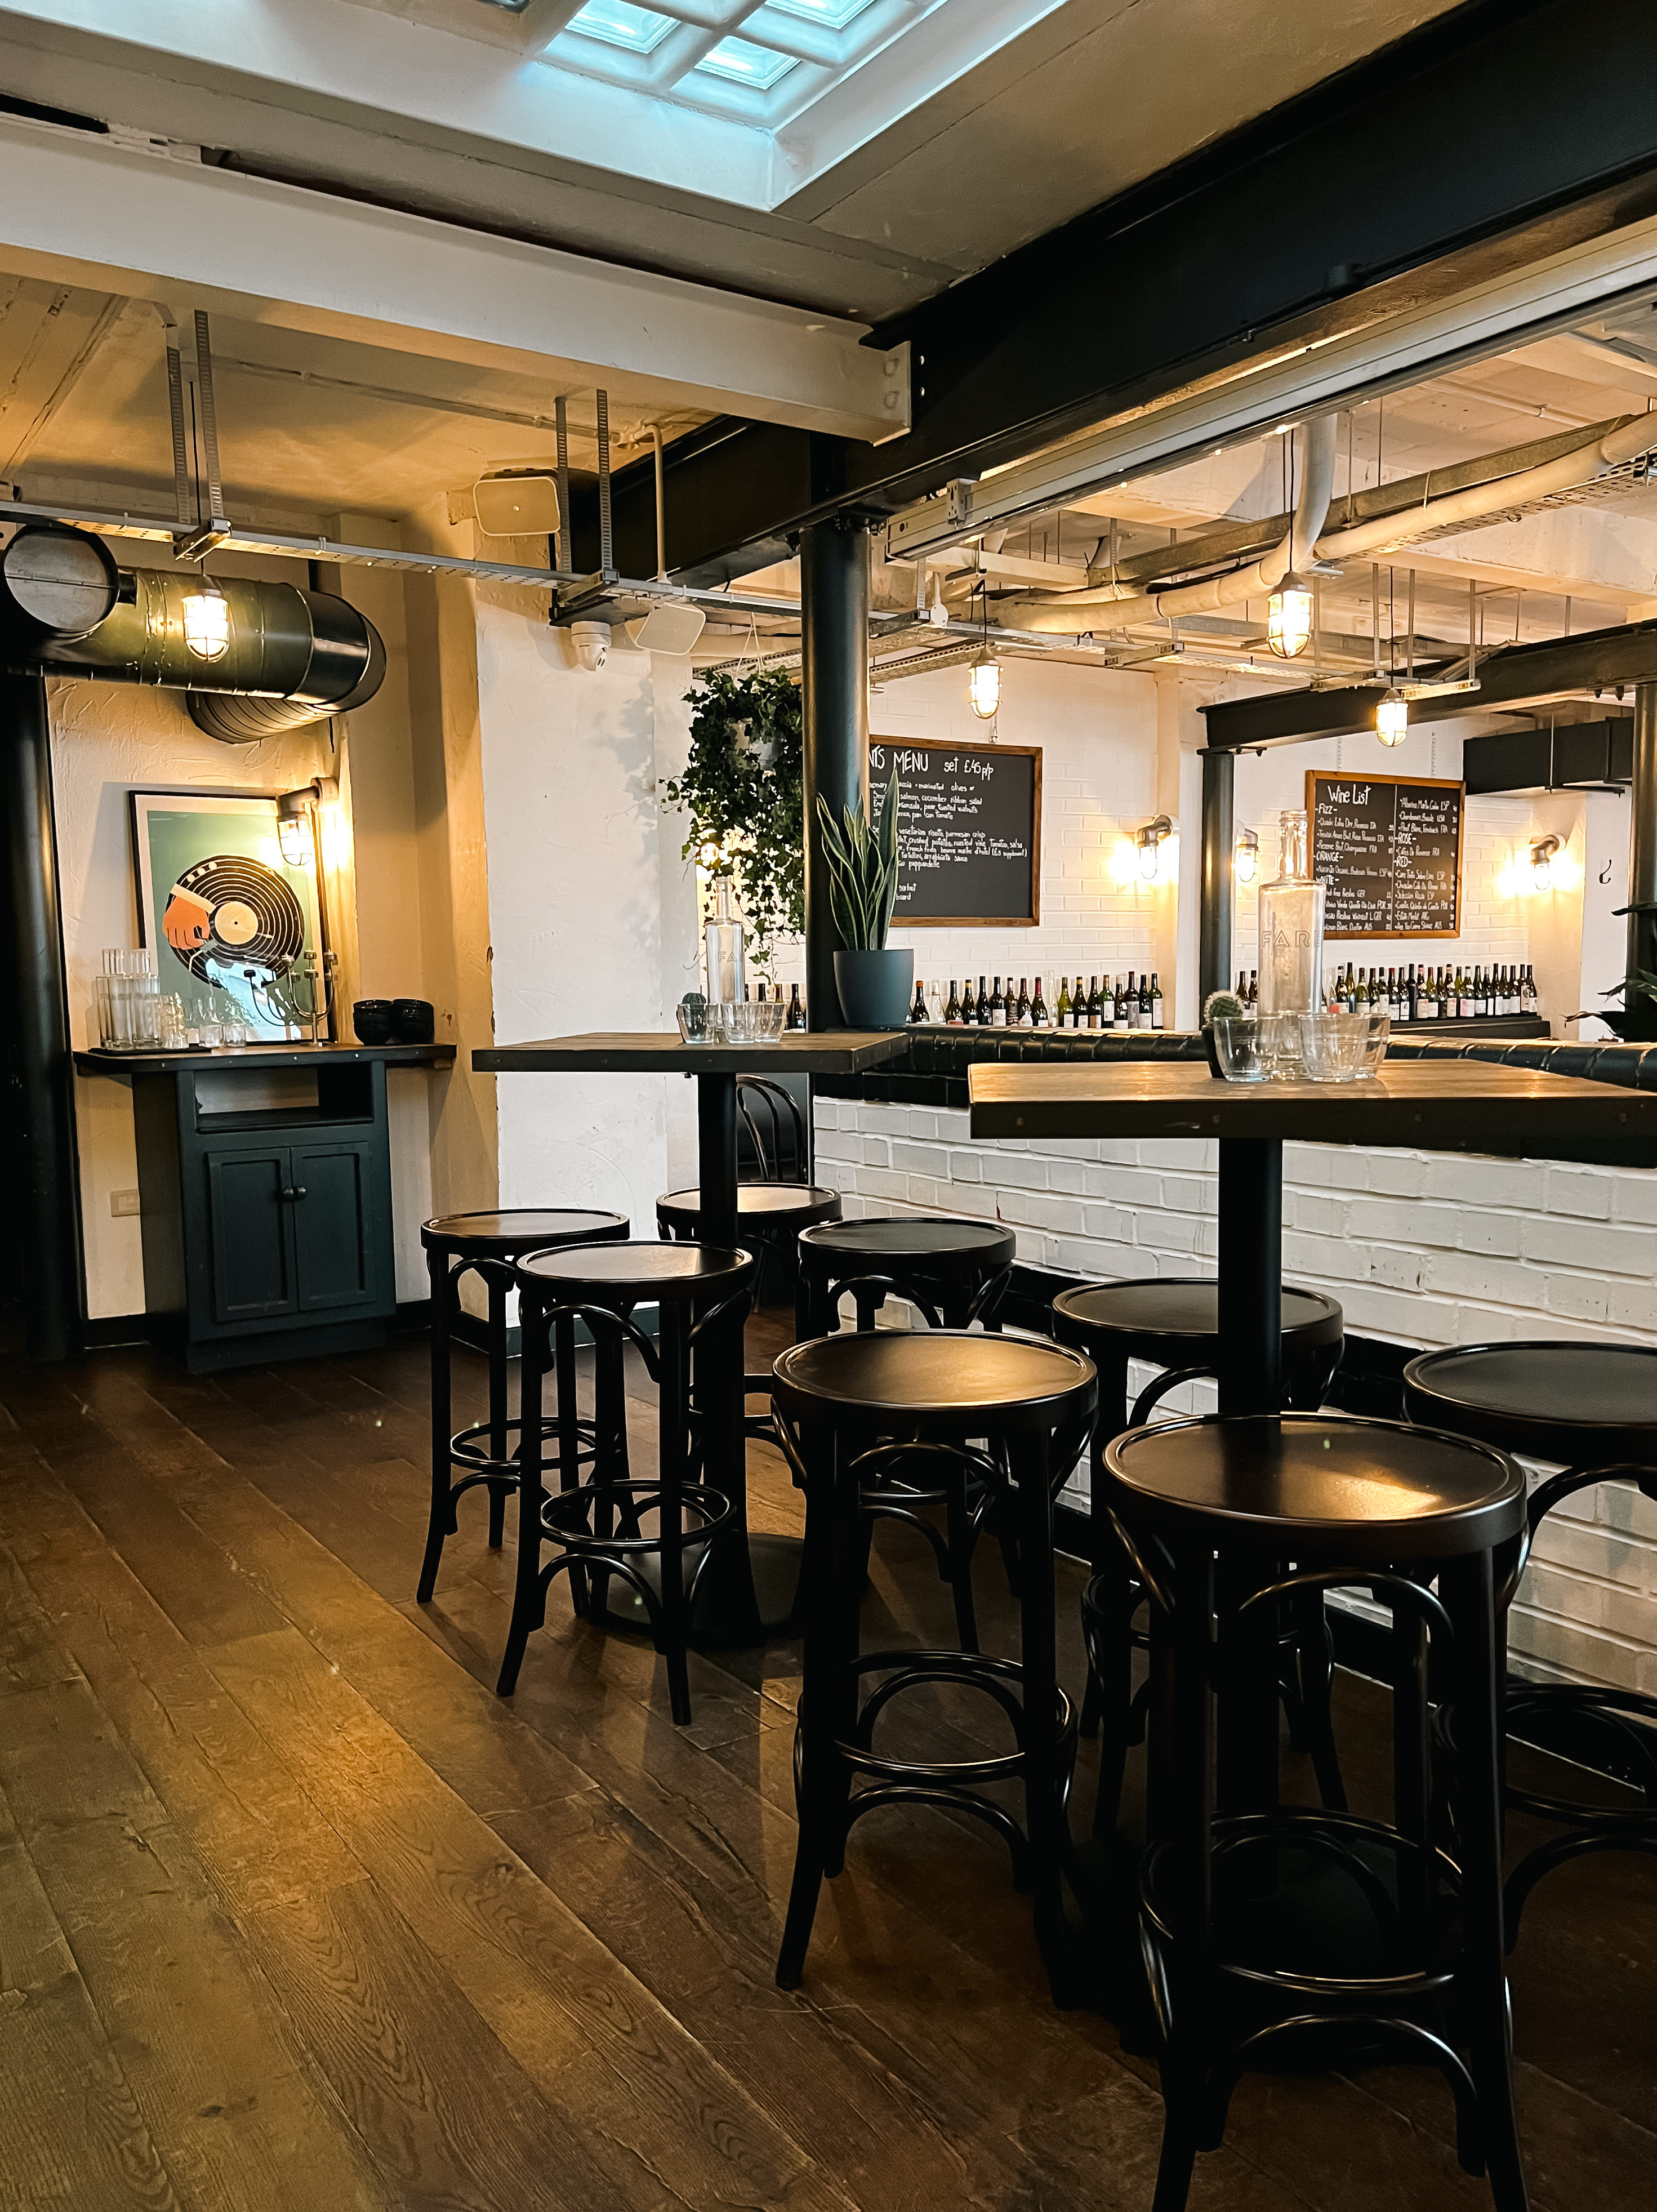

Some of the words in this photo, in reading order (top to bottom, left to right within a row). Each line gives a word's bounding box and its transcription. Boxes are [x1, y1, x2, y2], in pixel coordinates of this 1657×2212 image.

[893, 750, 928, 774] MENU
[943, 756, 959, 773] set
[951, 781, 968, 792] olives
[921, 793, 947, 803] cucumber
[950, 795, 967, 804] ribbon
[1327, 785, 1351, 804] Wine
[1352, 784, 1371, 805] List
[957, 804, 978, 813] walnuts
[912, 812, 921, 823] pan
[946, 831, 970, 846] parmesan
[972, 830, 986, 842] crisp
[954, 838, 973, 846] roasted
[1009, 838, 1023, 849] salsa
[906, 843, 923, 852] french
[908, 859, 940, 872] pappardelle
[898, 883, 917, 892] sorbet
